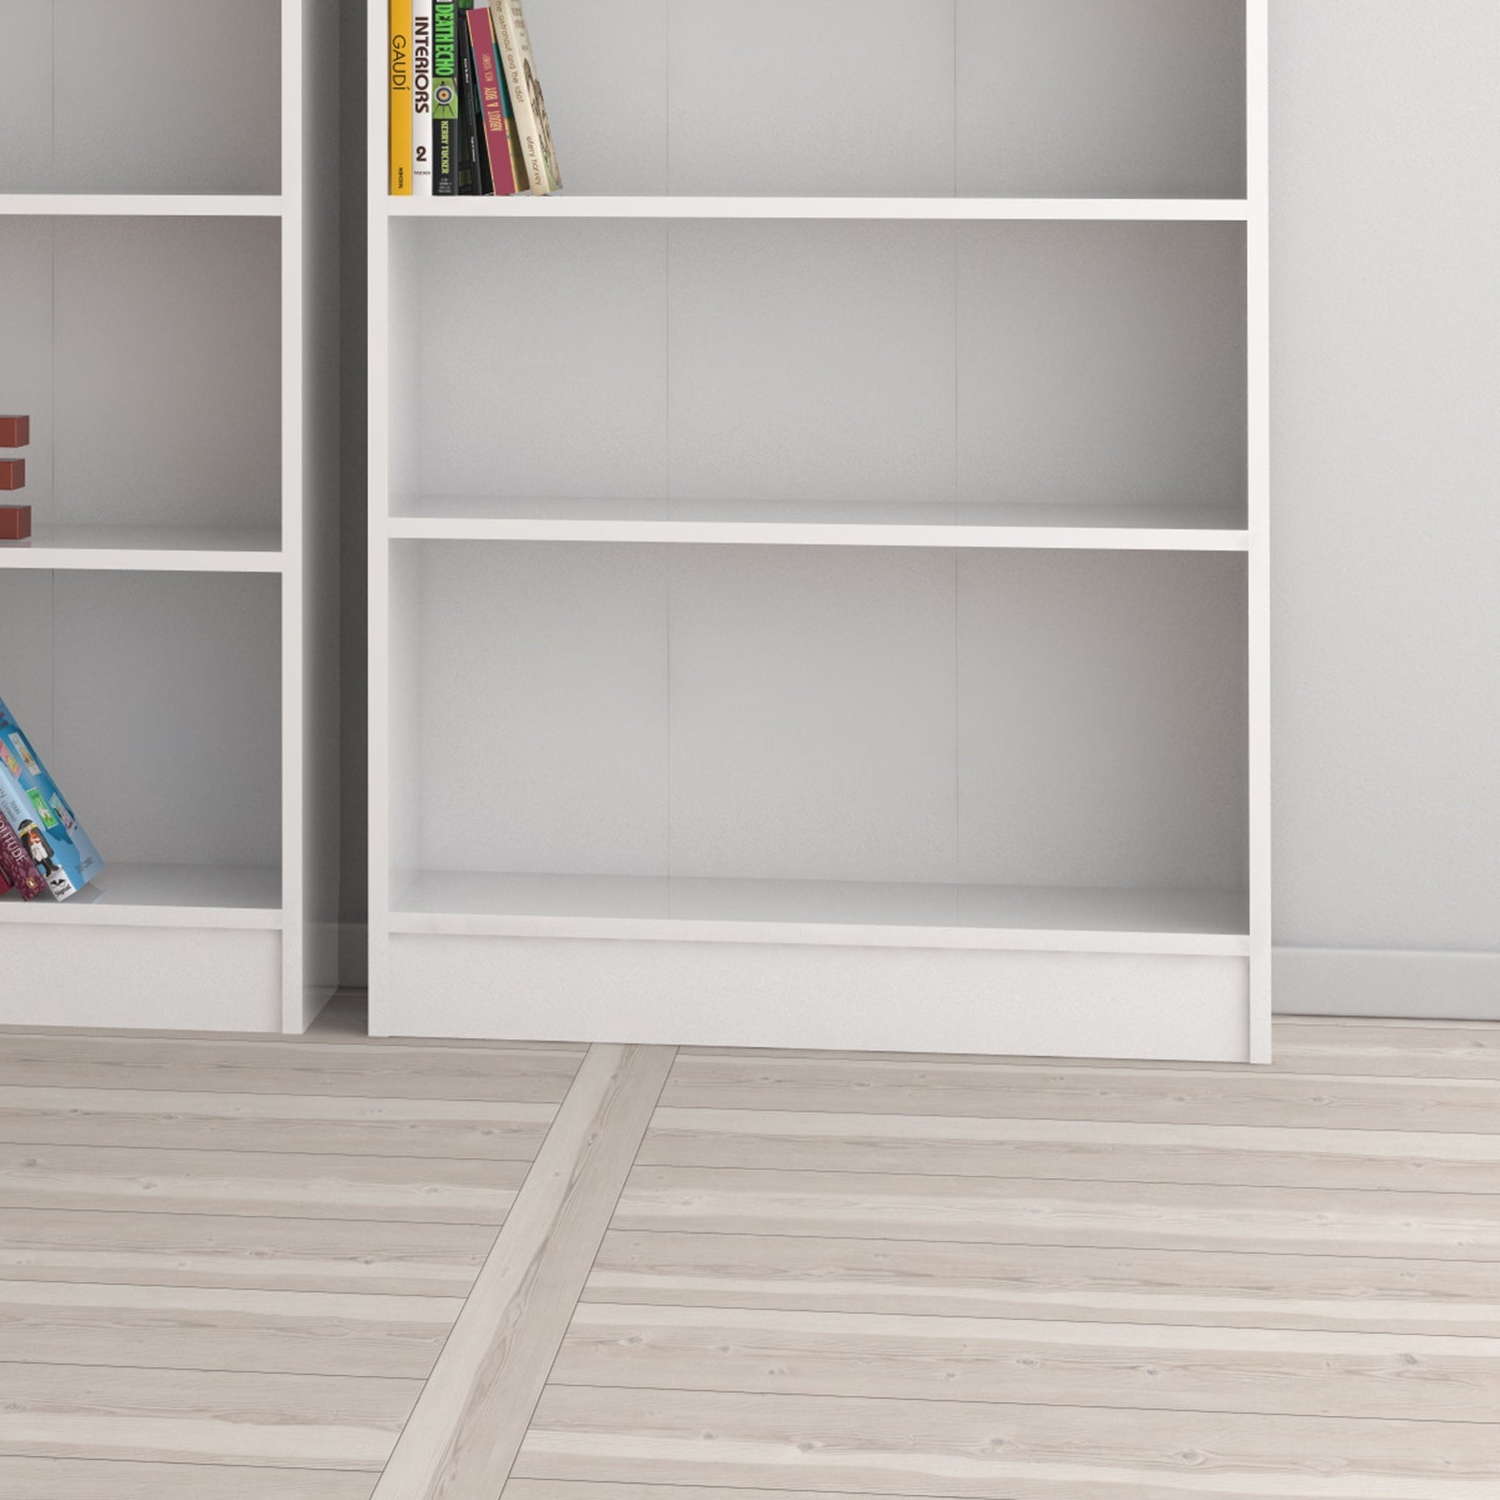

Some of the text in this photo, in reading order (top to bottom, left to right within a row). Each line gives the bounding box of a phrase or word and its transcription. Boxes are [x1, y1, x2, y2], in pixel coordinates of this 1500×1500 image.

[434, 3, 454, 42] DEATH
[499, 15, 512, 51] astronaut
[508, 55, 516, 70] and
[392, 34, 410, 91] GAUDÍ
[434, 44, 454, 76] ECHO
[415, 16, 429, 162] INTERIORS 2
[484, 86, 498, 100] BOY
[440, 120, 448, 143] KERRY
[490, 112, 502, 132] ABOUT
[440, 145, 449, 174] TUCKER
